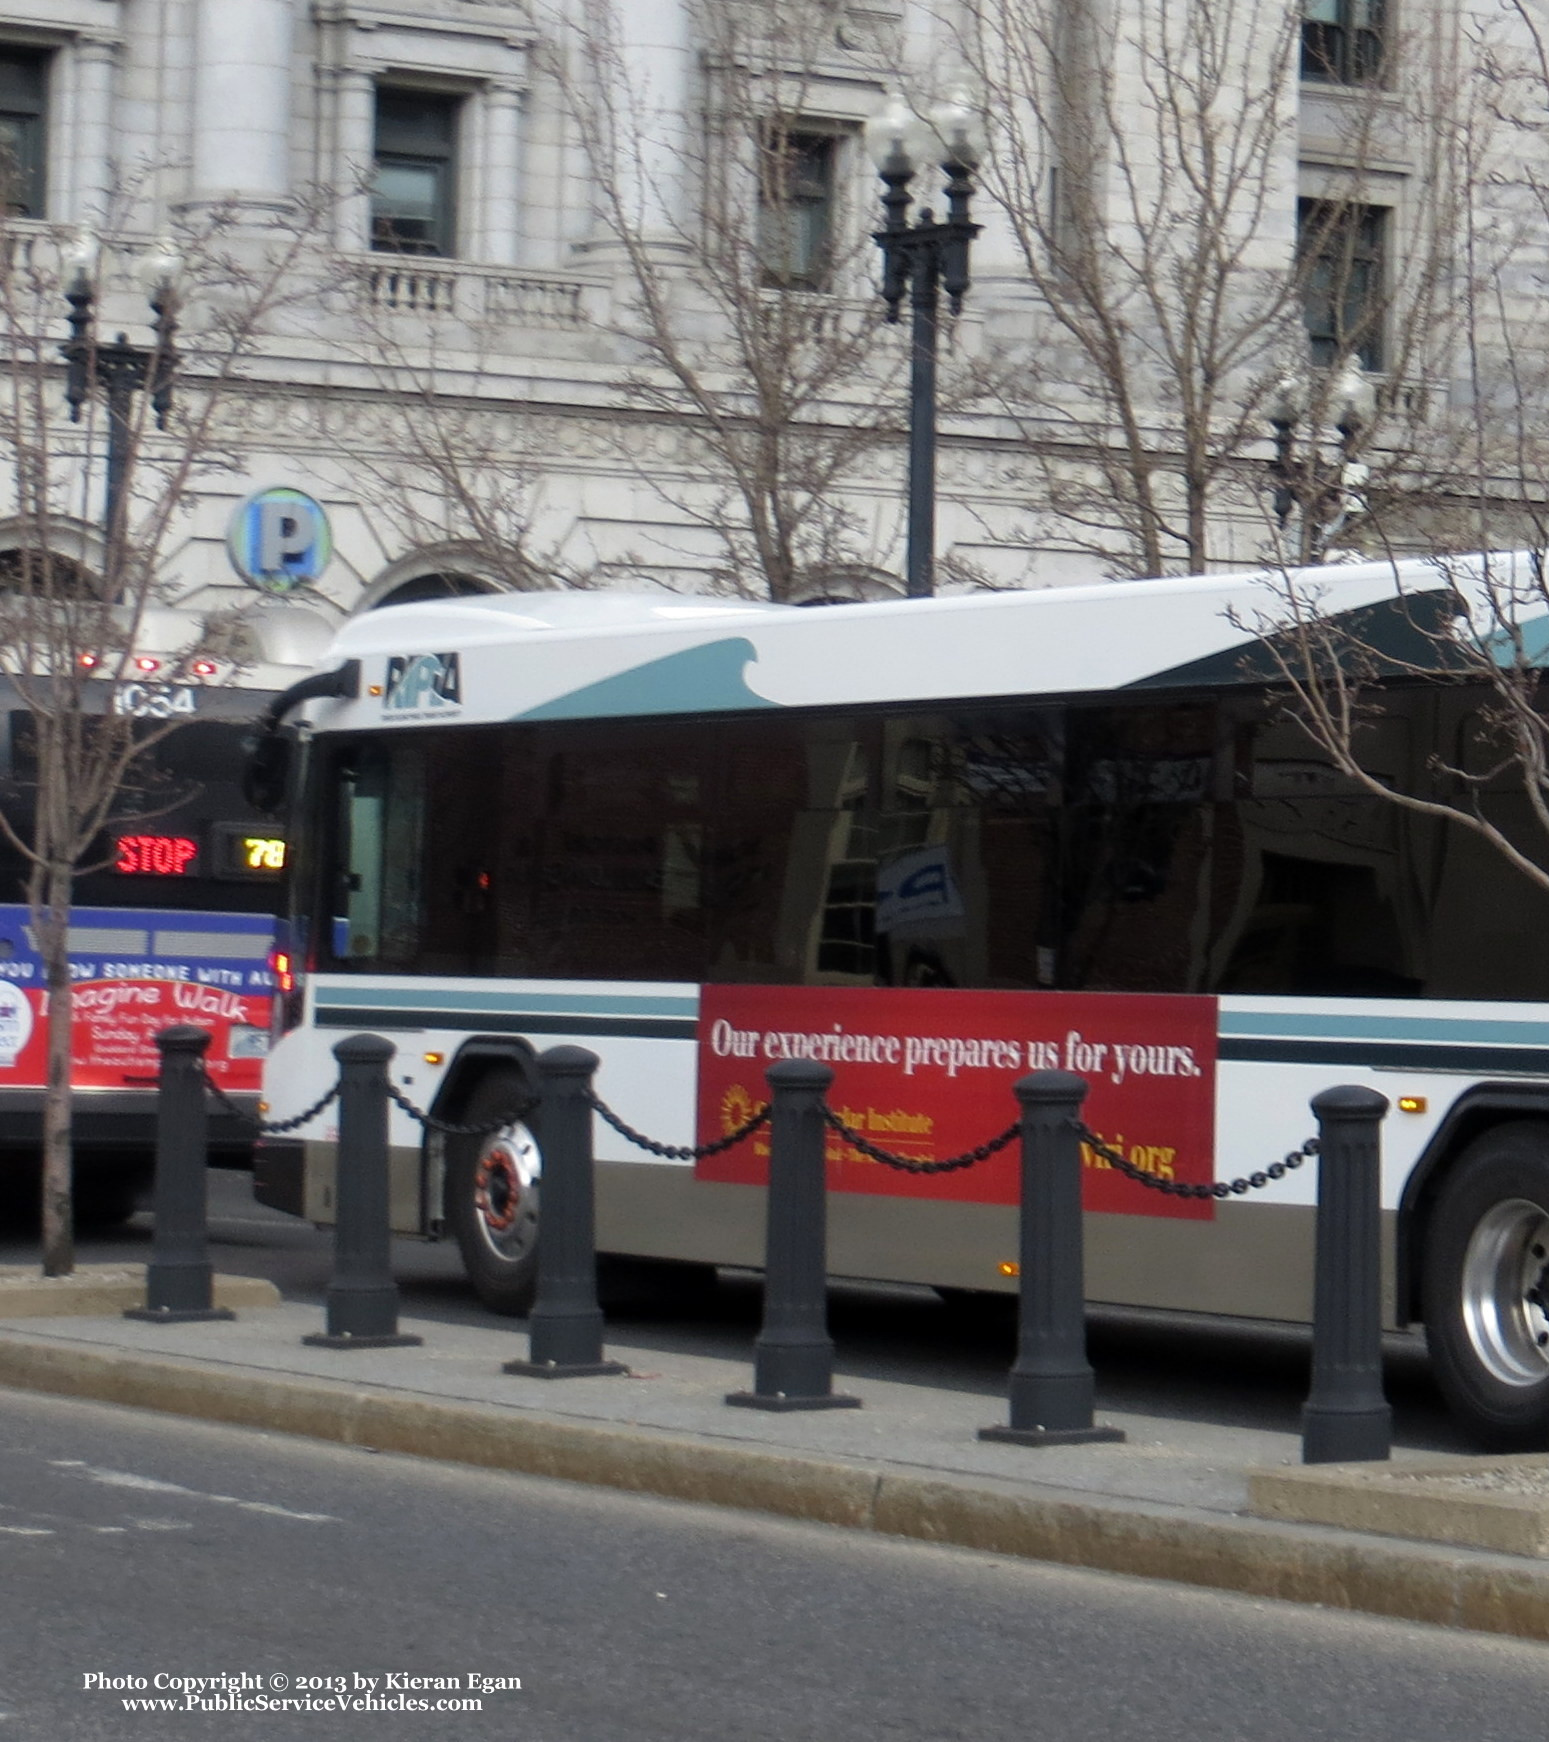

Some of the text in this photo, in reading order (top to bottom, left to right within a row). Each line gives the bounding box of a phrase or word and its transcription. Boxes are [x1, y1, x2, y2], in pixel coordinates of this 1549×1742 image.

[261, 502, 314, 572] P
[116, 835, 197, 874] STOP
[244, 838, 286, 868] 78
[103, 962, 190, 981] SOMEONE
[198, 968, 243, 986] WITH
[173, 981, 249, 1021] Walk
[711, 1018, 1202, 1085] Our experience prepares us for yours.
